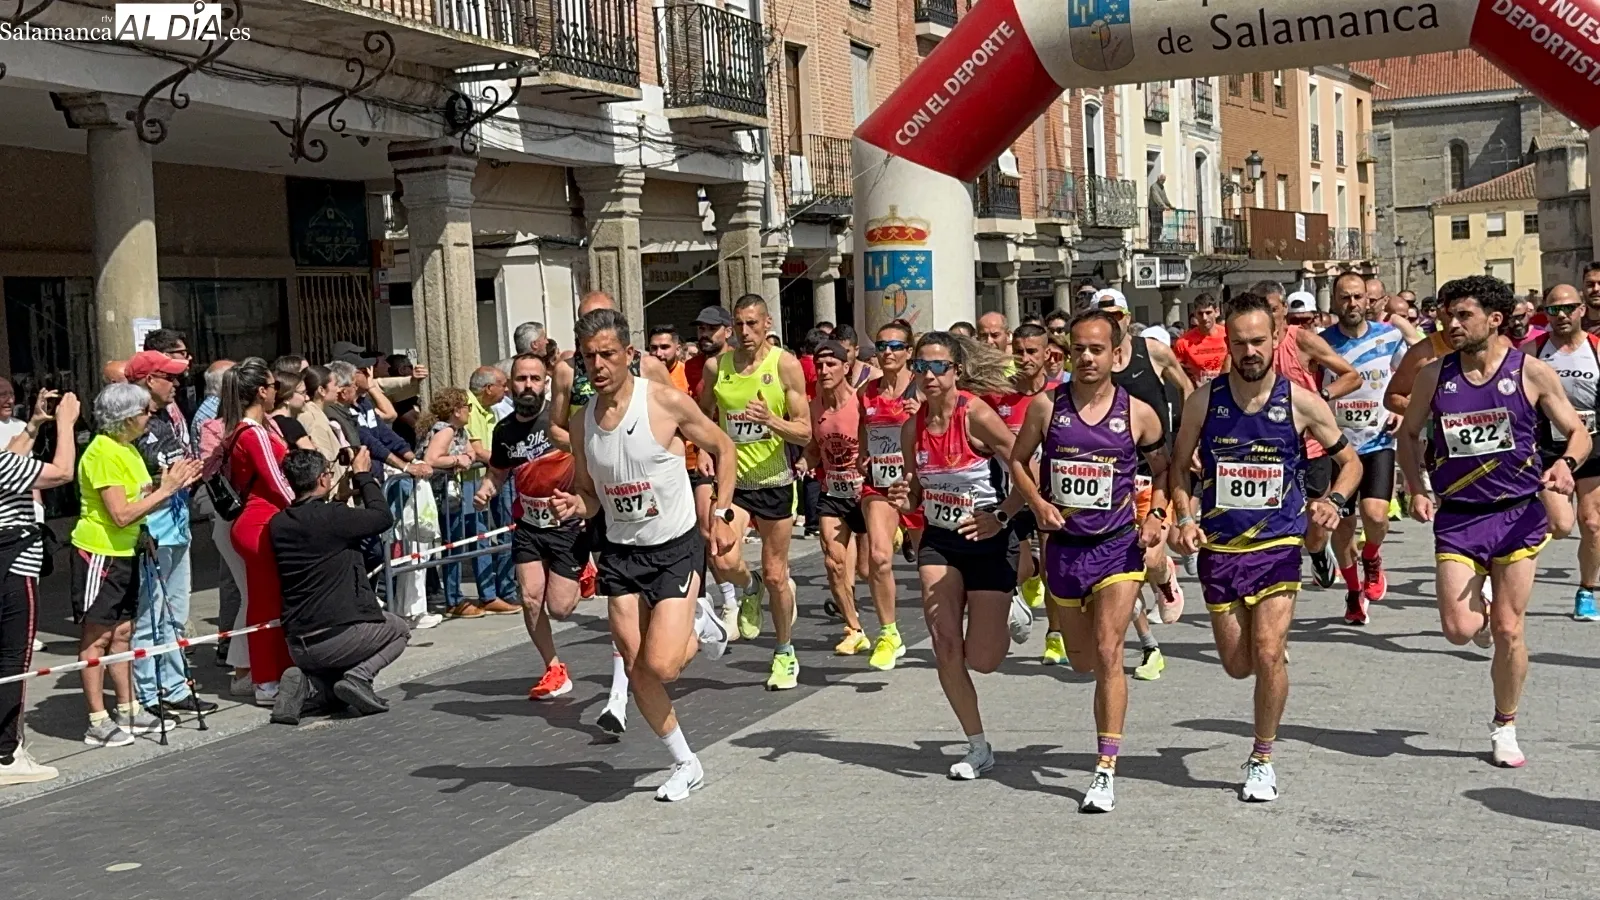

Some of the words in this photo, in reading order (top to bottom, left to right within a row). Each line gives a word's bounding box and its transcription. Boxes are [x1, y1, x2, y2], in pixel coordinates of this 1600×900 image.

[1157, 27, 1194, 55] de
[1209, 2, 1440, 50] Salamanca
[895, 108, 931, 146] CON
[925, 92, 950, 115] EL
[943, 20, 1015, 96] DEPORTE
[1345, 410, 1371, 422] 829
[1443, 412, 1508, 429] bedunia
[734, 422, 763, 435] 773
[1458, 424, 1499, 445] 822
[880, 465, 904, 478] 781
[1052, 465, 1112, 477] bedunia
[1218, 466, 1283, 478] bedunia
[604, 482, 652, 496] bedunia
[833, 481, 855, 492] 881
[1061, 478, 1099, 496] 800
[1230, 480, 1268, 498] 801
[614, 495, 643, 513] 837
[934, 504, 963, 522] 739
